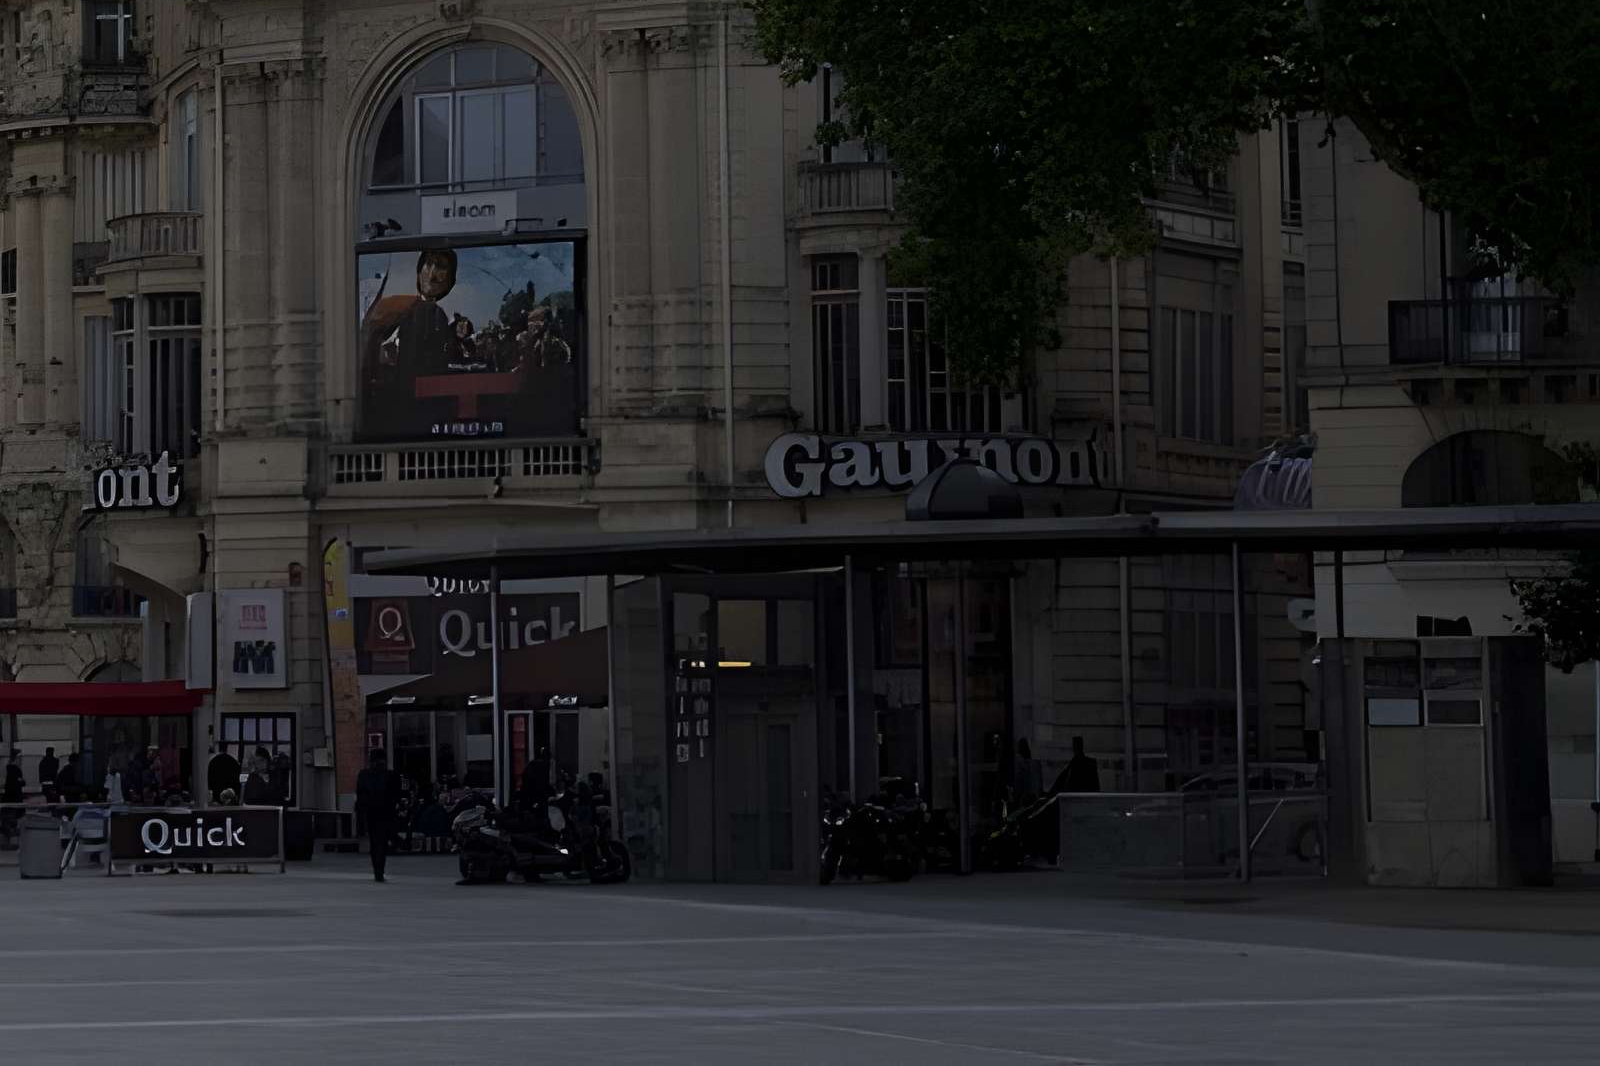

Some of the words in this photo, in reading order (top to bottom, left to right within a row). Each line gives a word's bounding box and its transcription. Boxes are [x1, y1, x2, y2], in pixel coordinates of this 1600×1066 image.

[98, 450, 180, 507] ont
[439, 606, 576, 657] Quick
[141, 817, 246, 854] Quick
